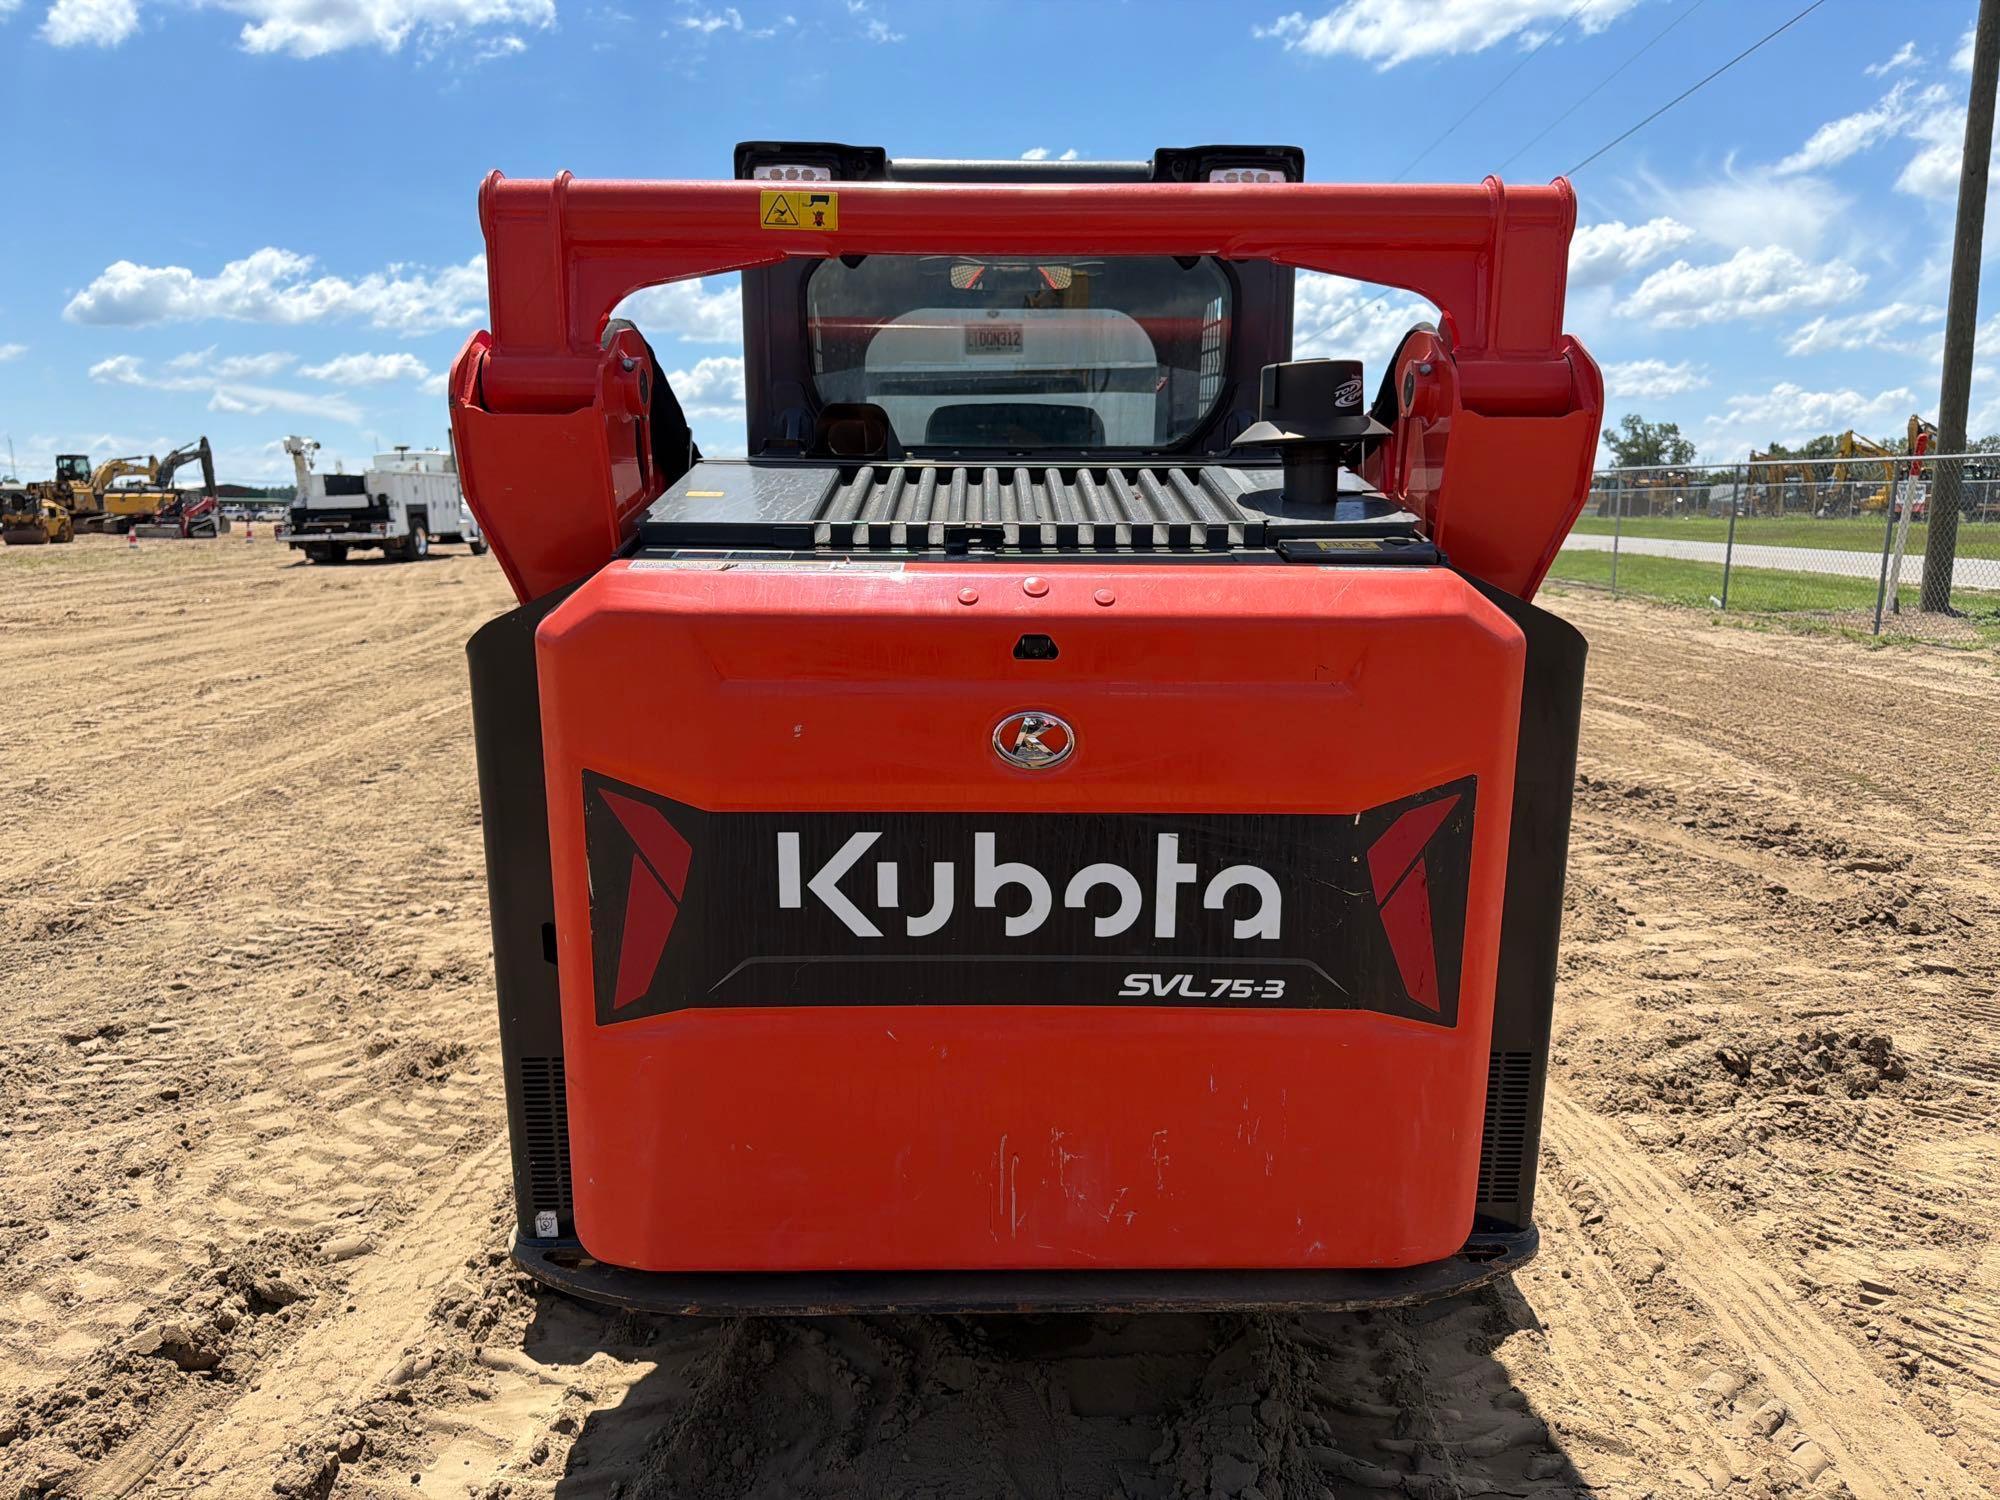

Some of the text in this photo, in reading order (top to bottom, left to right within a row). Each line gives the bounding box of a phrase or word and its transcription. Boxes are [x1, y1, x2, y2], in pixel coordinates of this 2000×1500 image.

[777, 831, 1282, 940] Kubota
[1118, 973, 1286, 999] SVL 75-3
